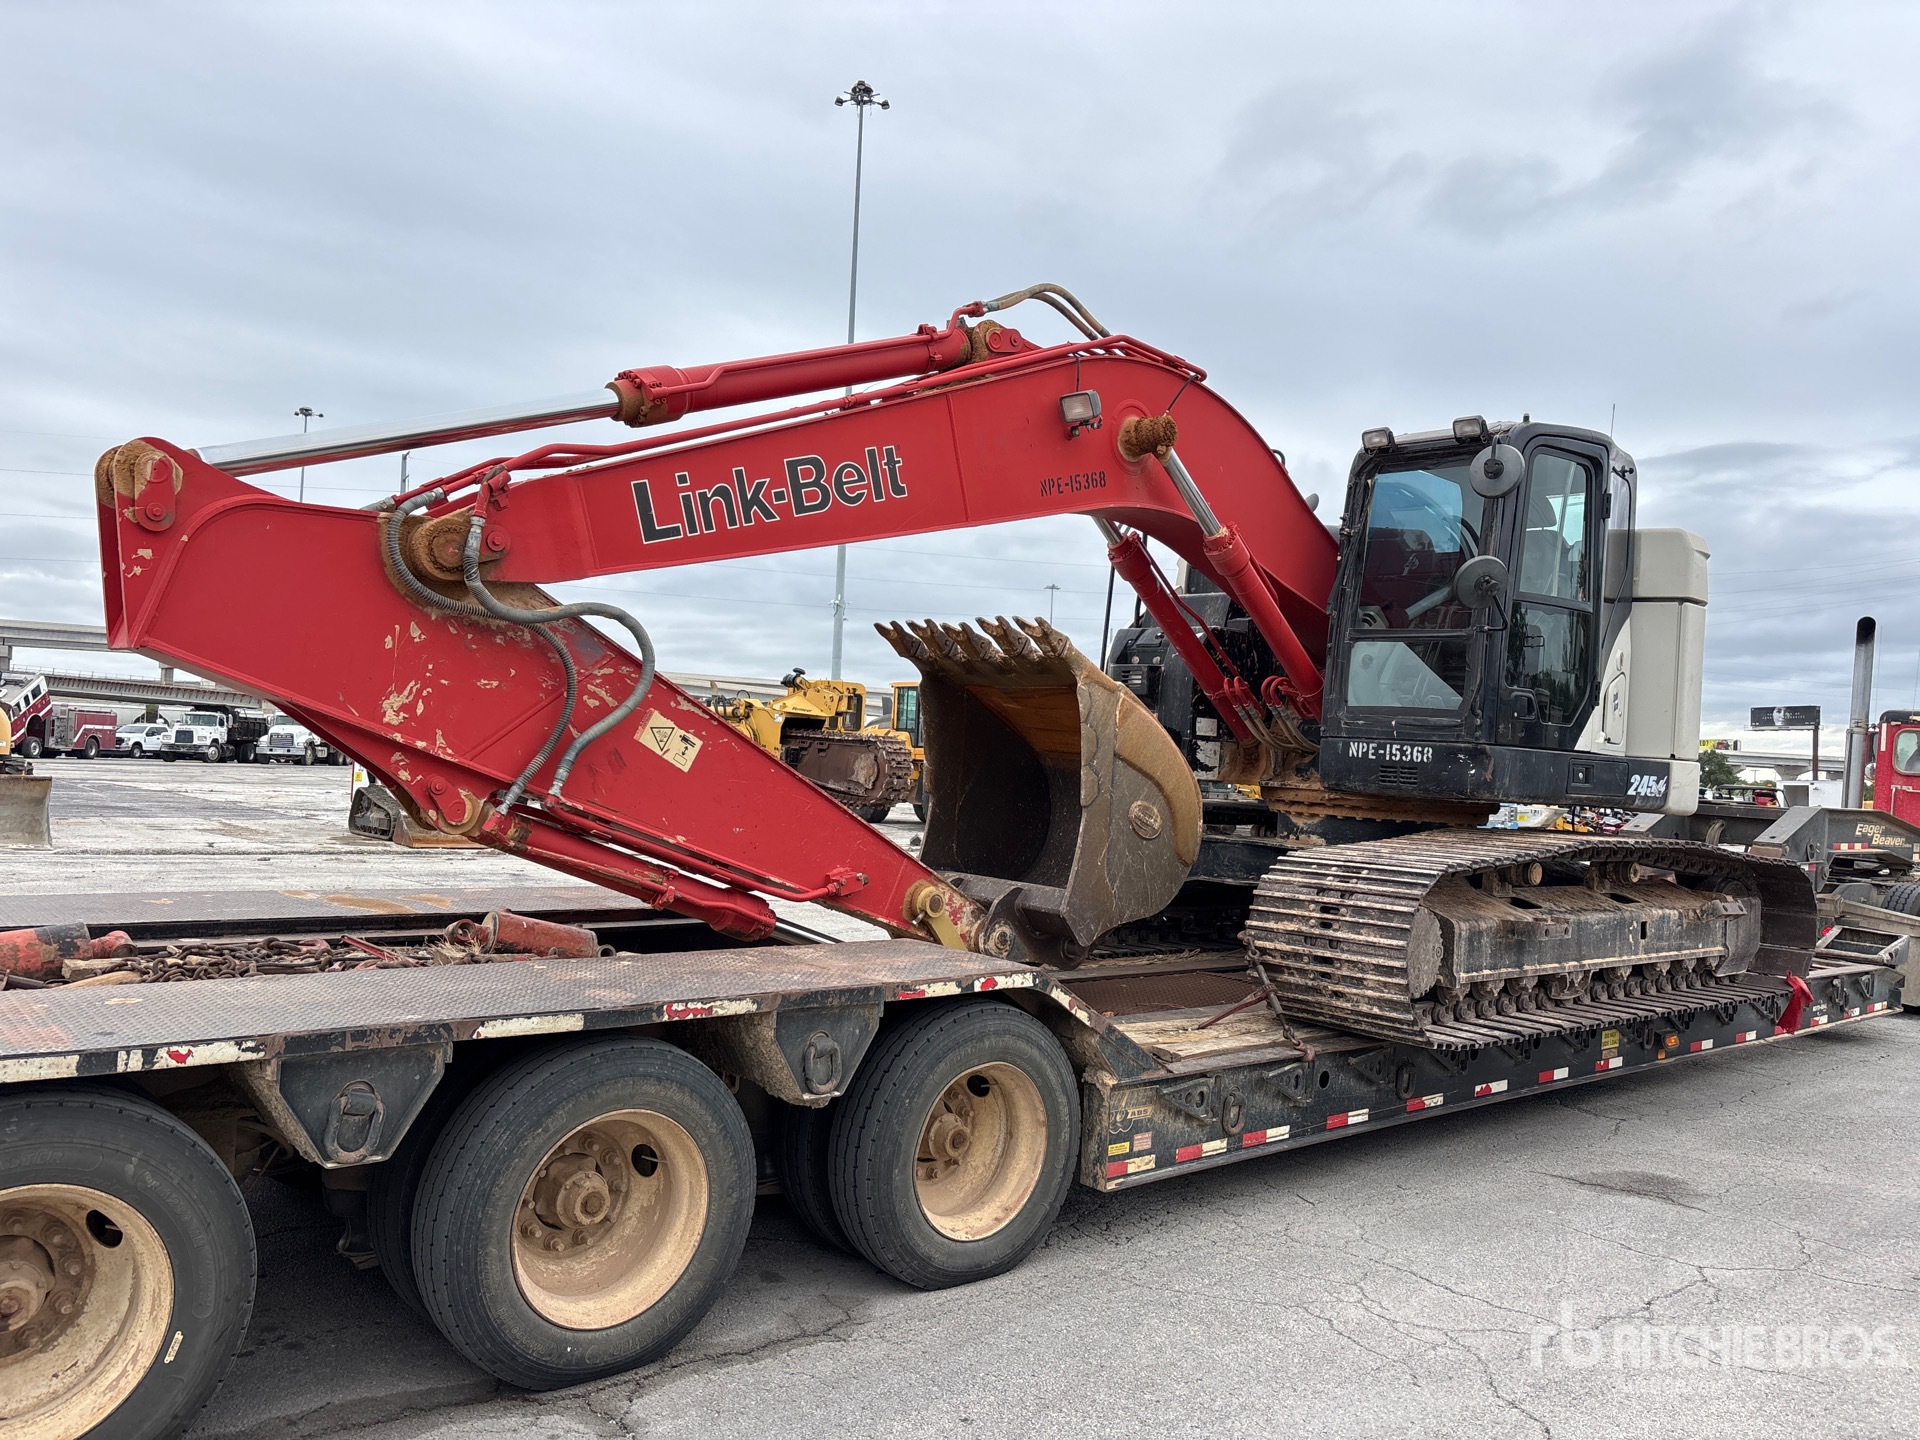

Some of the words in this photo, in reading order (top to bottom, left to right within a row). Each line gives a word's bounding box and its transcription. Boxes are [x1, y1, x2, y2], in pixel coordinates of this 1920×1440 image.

[1039, 470, 1108, 498] NPE-15368
[631, 445, 908, 545] Link-Belt
[1348, 741, 1433, 764] NPE-15368
[1855, 822, 1886, 837] Eager
[1871, 833, 1906, 846] Beaver
[1130, 1108, 1148, 1118] ABS
